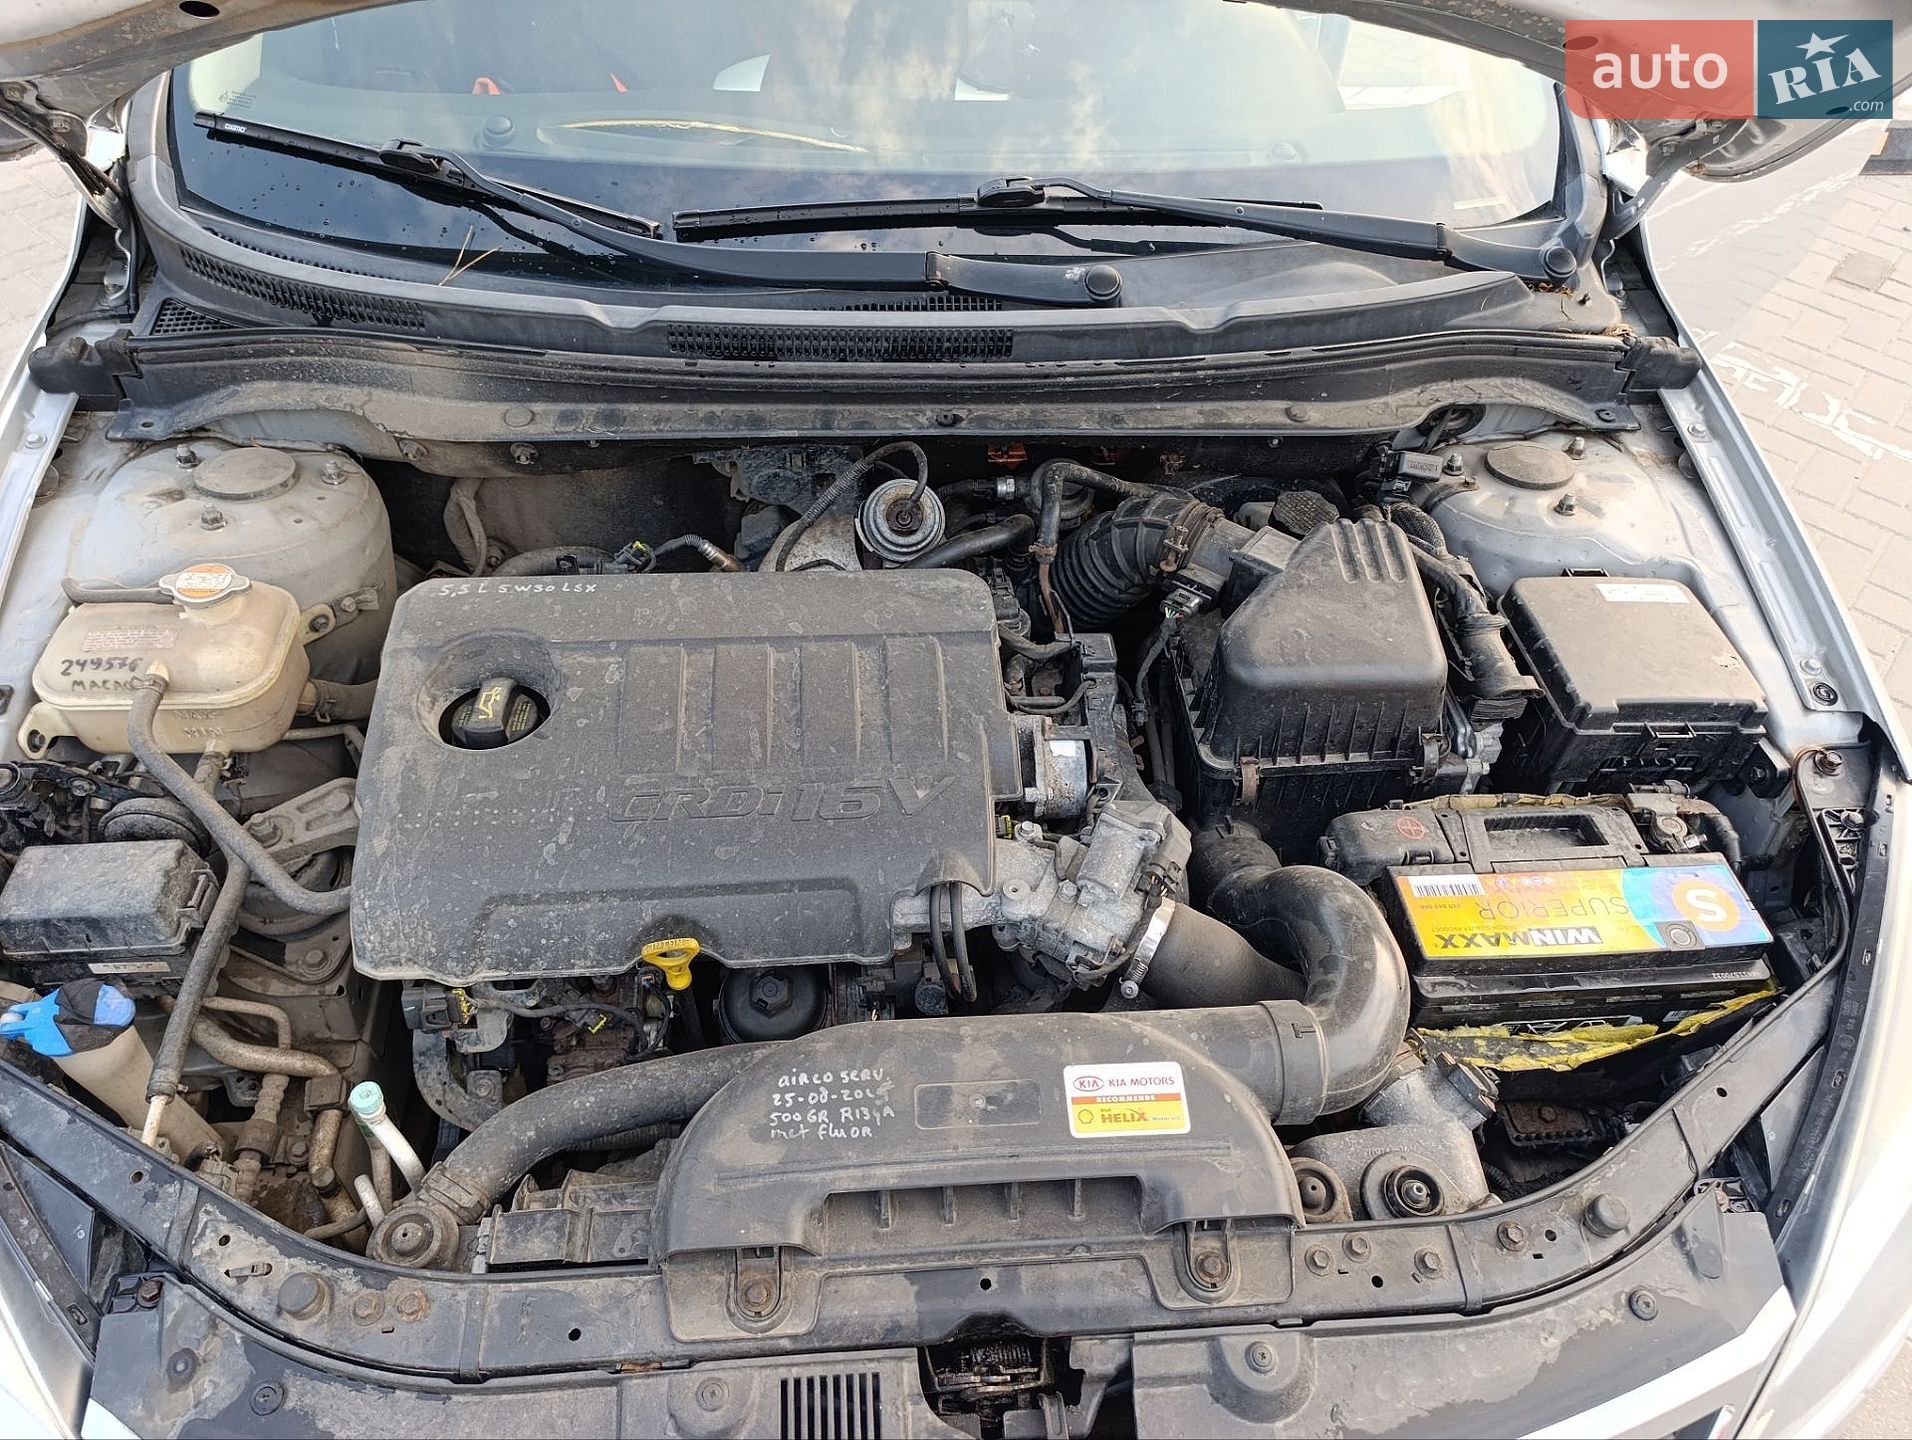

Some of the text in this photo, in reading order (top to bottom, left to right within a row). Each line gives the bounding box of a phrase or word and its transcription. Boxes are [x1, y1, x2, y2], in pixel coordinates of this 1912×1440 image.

[1475, 895, 1630, 921] SUPERIOR
[1108, 1076, 1175, 1088] KIA MOTORS
[1095, 1094, 1157, 1104] RECOMMENDS
[769, 1111, 802, 1126] 500
[1101, 1111, 1149, 1124] HELIX
